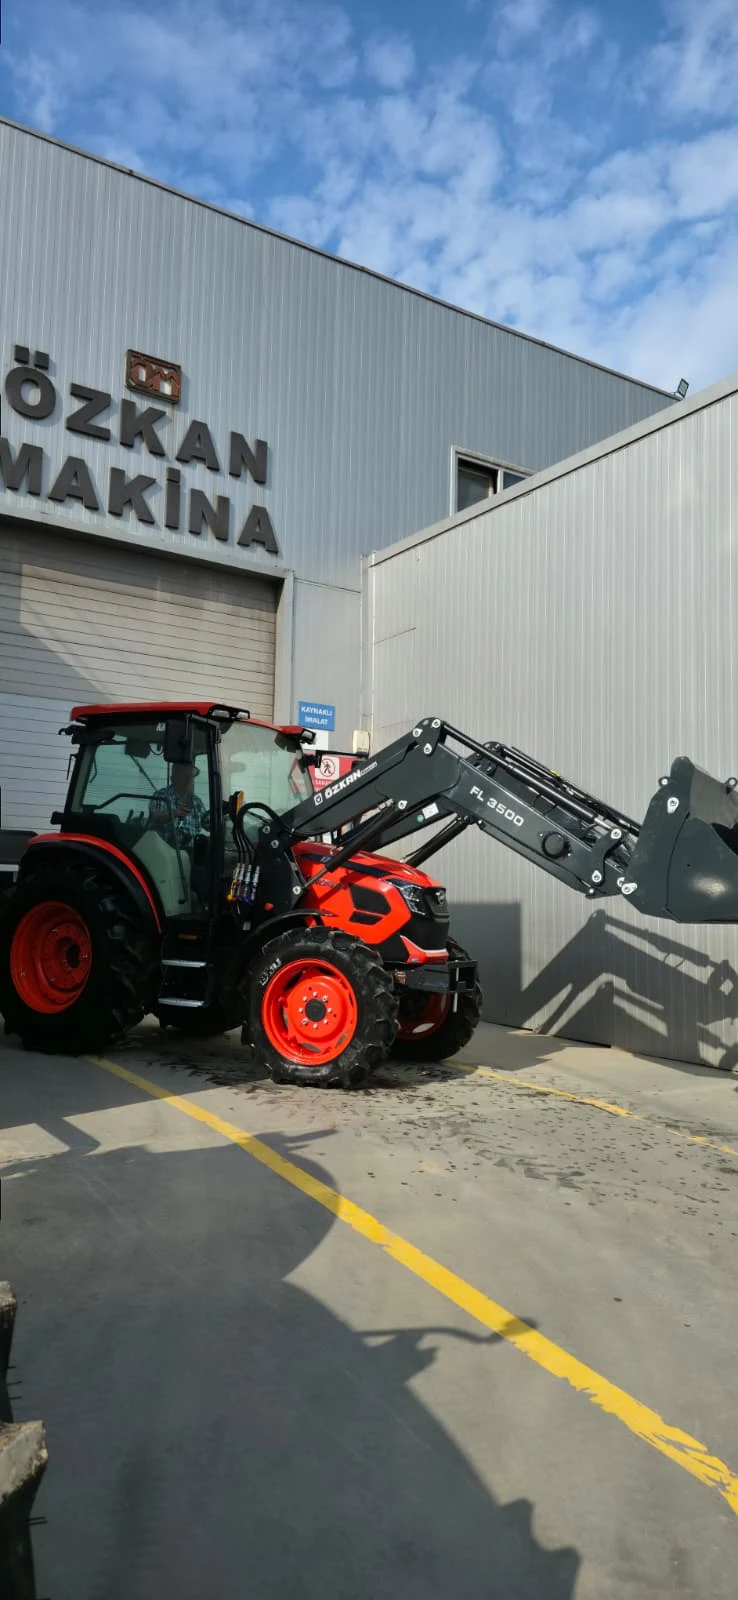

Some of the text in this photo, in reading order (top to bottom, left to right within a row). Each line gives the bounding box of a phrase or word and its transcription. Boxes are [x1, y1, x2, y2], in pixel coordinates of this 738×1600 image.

[5, 344, 268, 485] ÖZKAN
[0, 437, 279, 554] MAKİNA
[301, 705, 332, 716] KAYNAKLI
[324, 769, 361, 799] ÖZKAN
[469, 785, 525, 827] FL 3500
